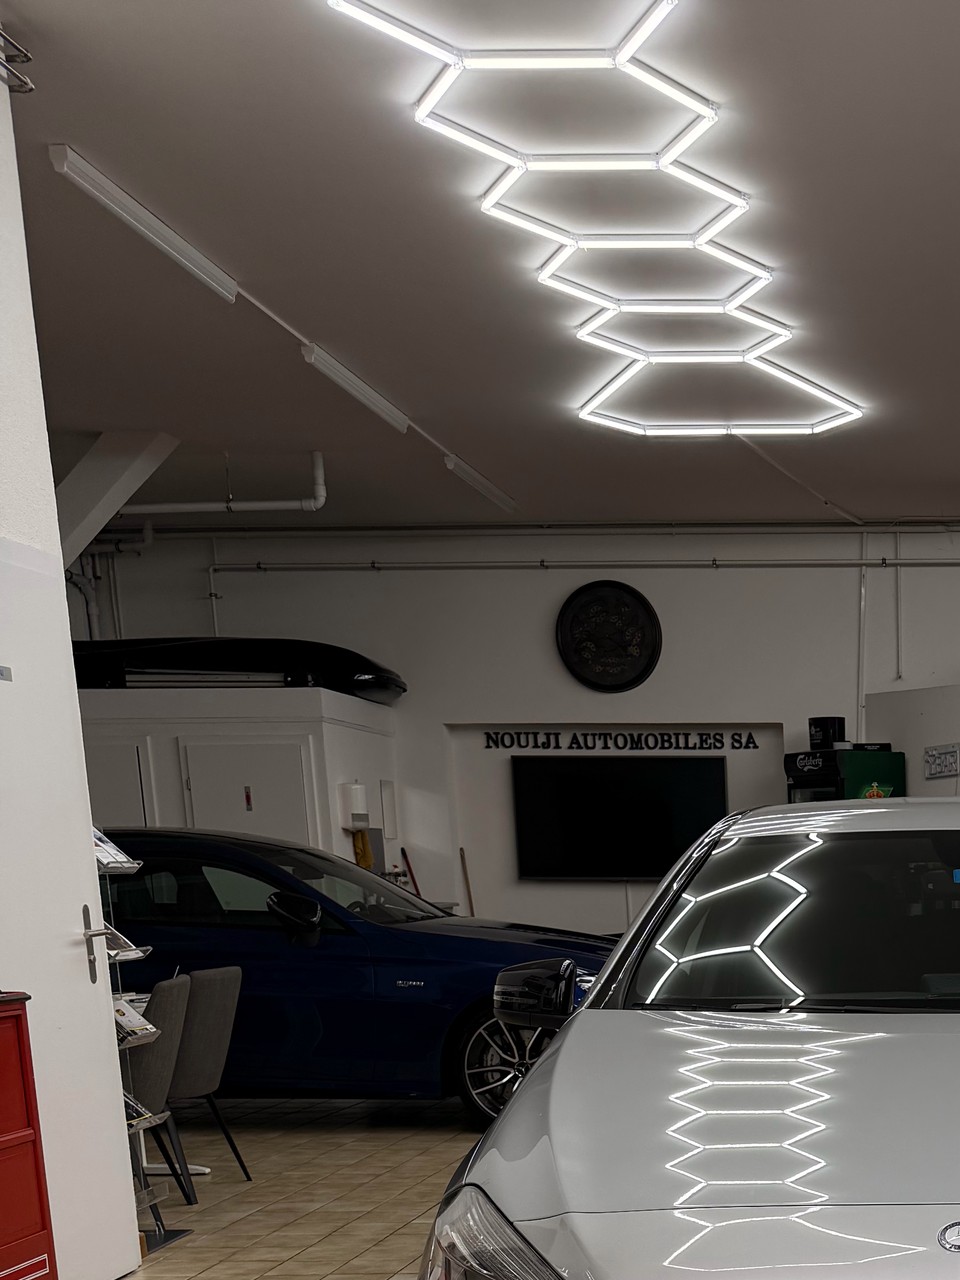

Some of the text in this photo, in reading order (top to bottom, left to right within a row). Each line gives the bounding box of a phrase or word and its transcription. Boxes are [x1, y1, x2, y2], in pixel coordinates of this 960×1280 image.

[484, 731, 760, 751] NOUIJI AUTOMOBILES SA
[796, 753, 823, 772] Carlsberg
